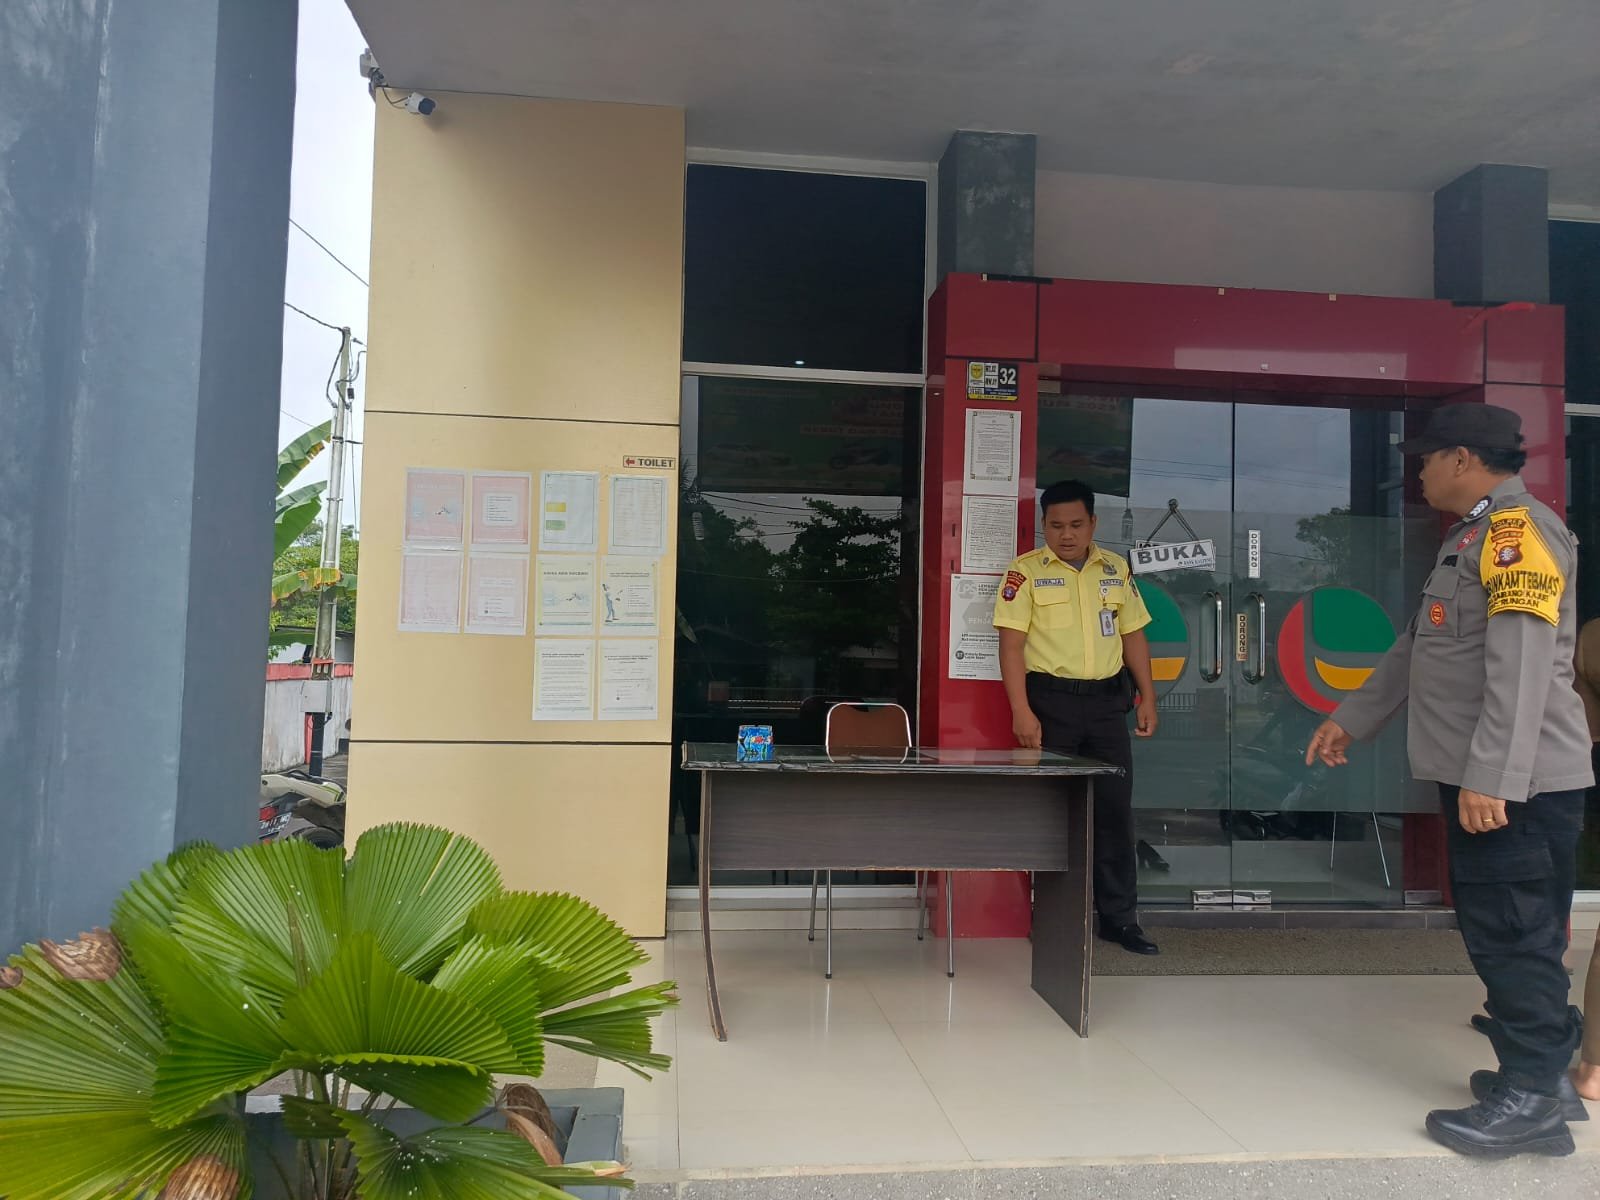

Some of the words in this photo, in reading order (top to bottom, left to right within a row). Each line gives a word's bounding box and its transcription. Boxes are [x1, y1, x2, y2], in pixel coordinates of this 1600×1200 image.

[1000, 368, 1017, 385] 32
[638, 458, 673, 468] TOILET
[1137, 543, 1207, 565] BUKA
